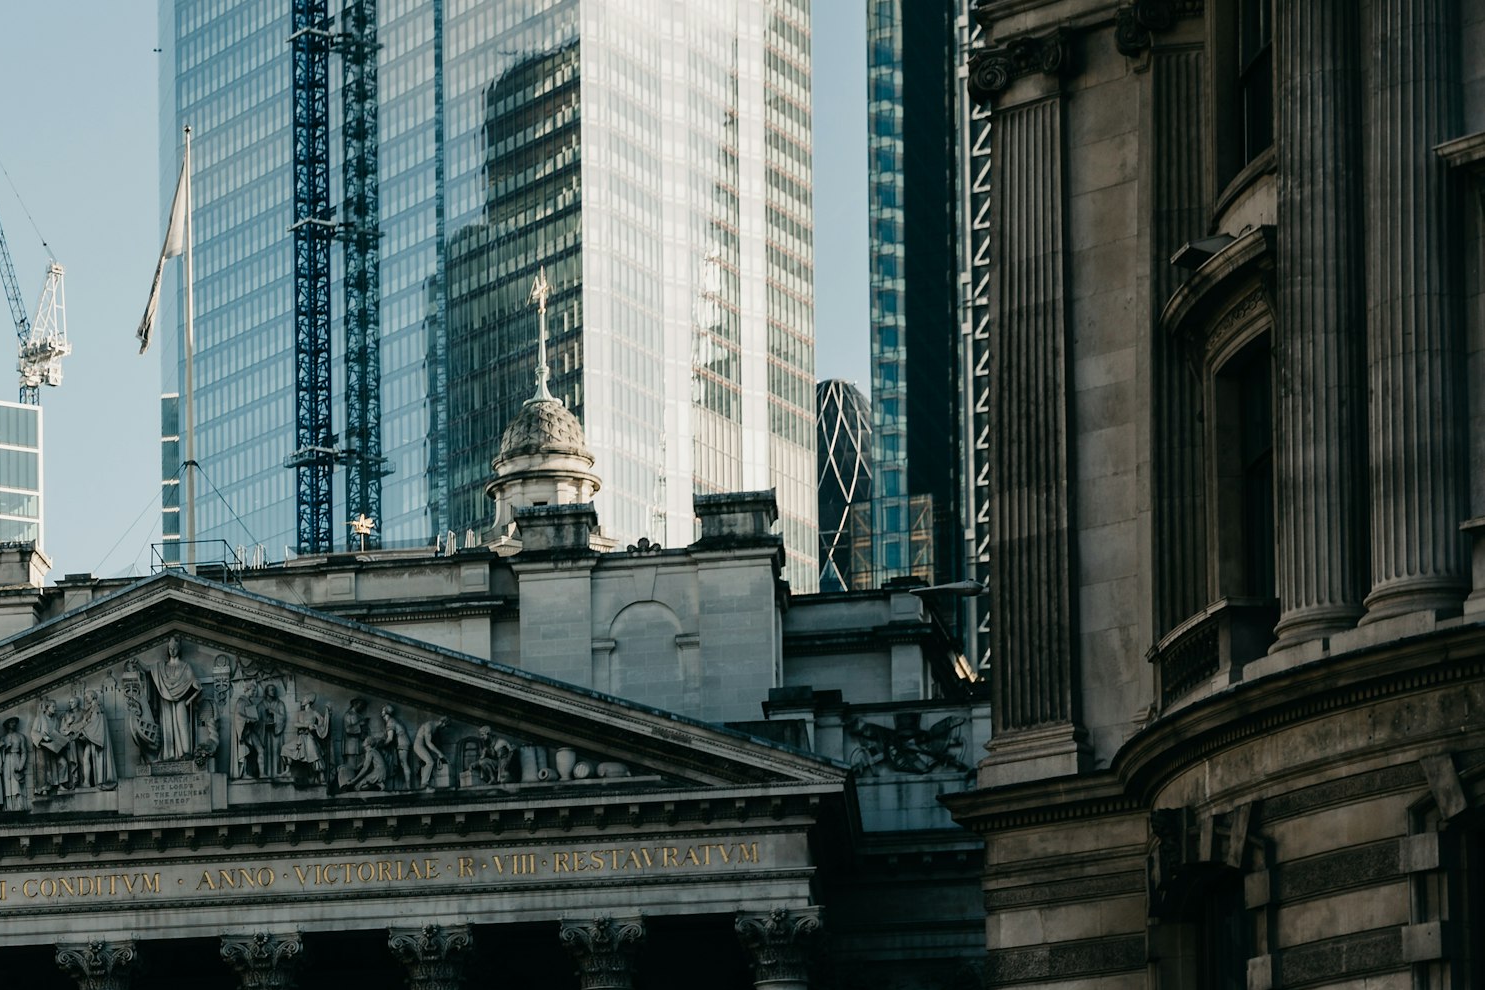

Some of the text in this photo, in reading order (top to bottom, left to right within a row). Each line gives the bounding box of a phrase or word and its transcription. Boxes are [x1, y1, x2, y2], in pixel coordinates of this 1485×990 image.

[22, 872, 162, 899] CONDITVM
[196, 866, 276, 891] ANNO
[292, 857, 441, 886] VICTORIAE
[458, 856, 476, 878] R
[493, 853, 537, 876] VIII
[553, 841, 761, 873] RESTAVRATVM
